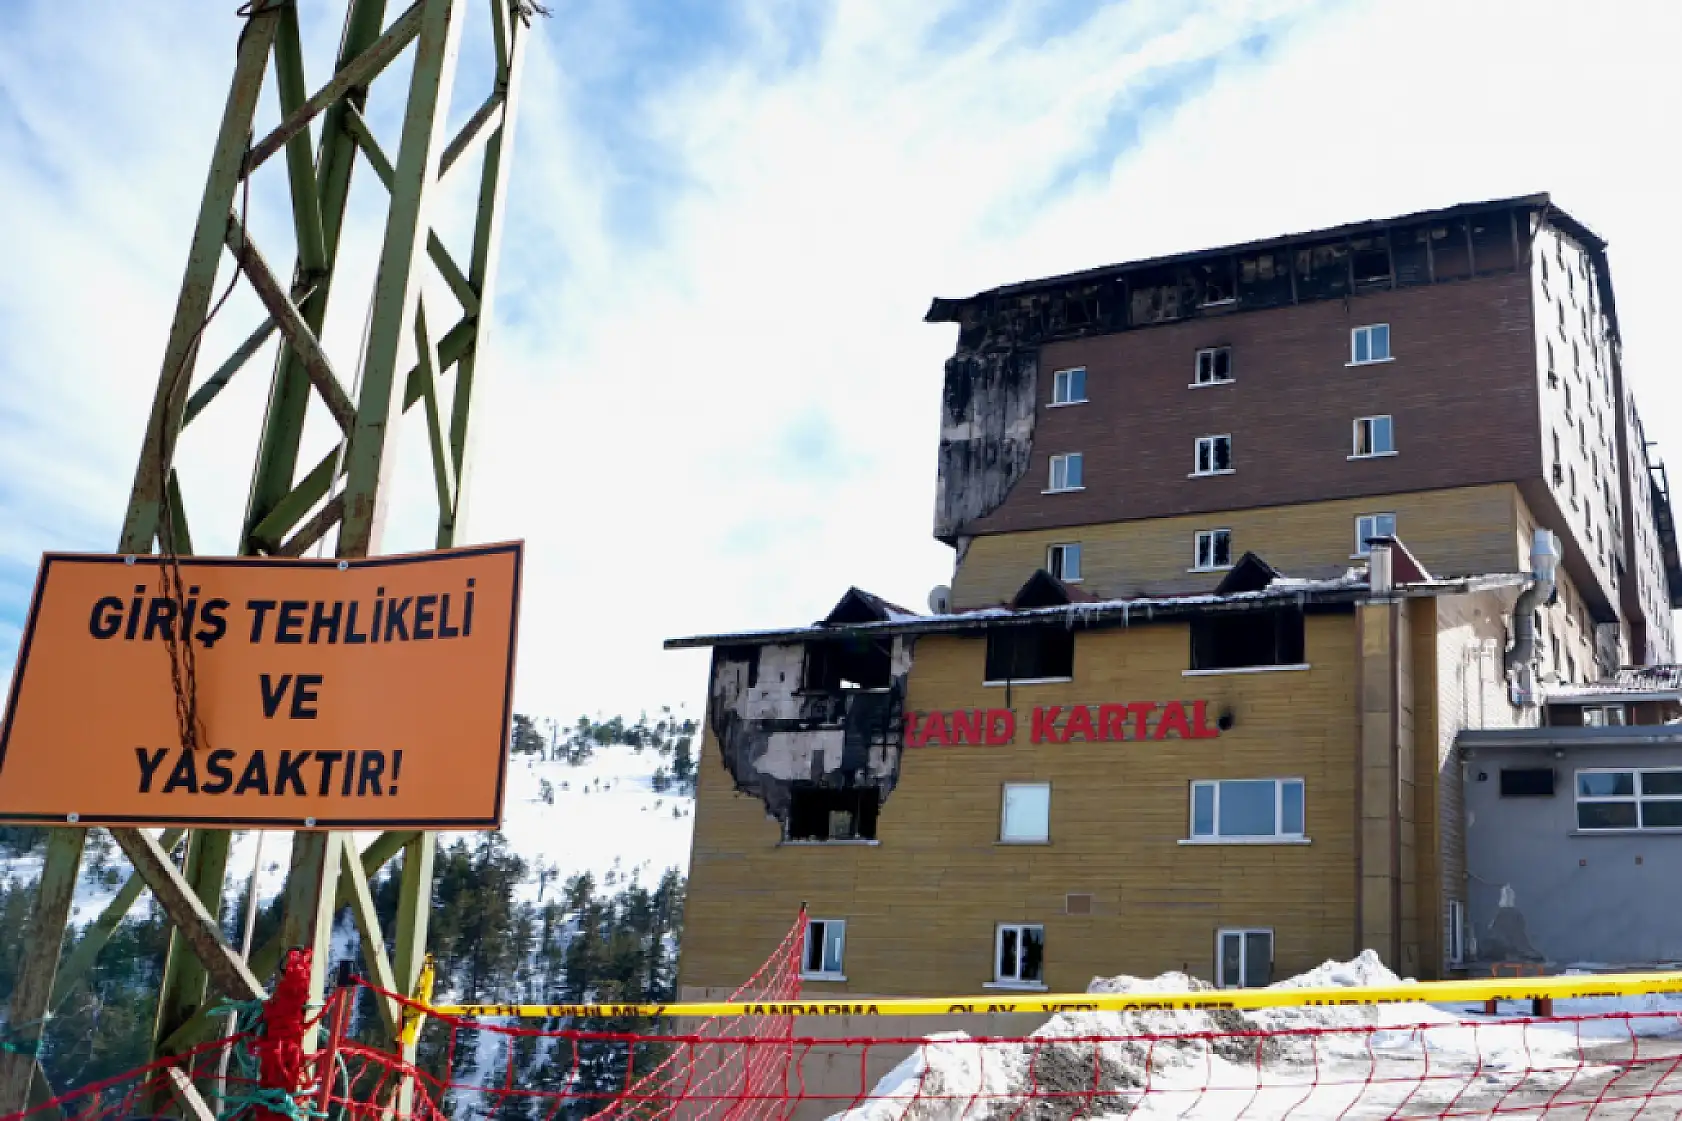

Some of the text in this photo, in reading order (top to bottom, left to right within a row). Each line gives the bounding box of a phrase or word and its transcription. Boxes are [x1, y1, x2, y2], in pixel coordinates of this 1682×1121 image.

[88, 577, 477, 648] GİRİŞ TEHLİKELİ
[259, 673, 324, 720] VE
[1029, 699, 1220, 744] KARTAL
[134, 747, 404, 798] YASAKTIR!
